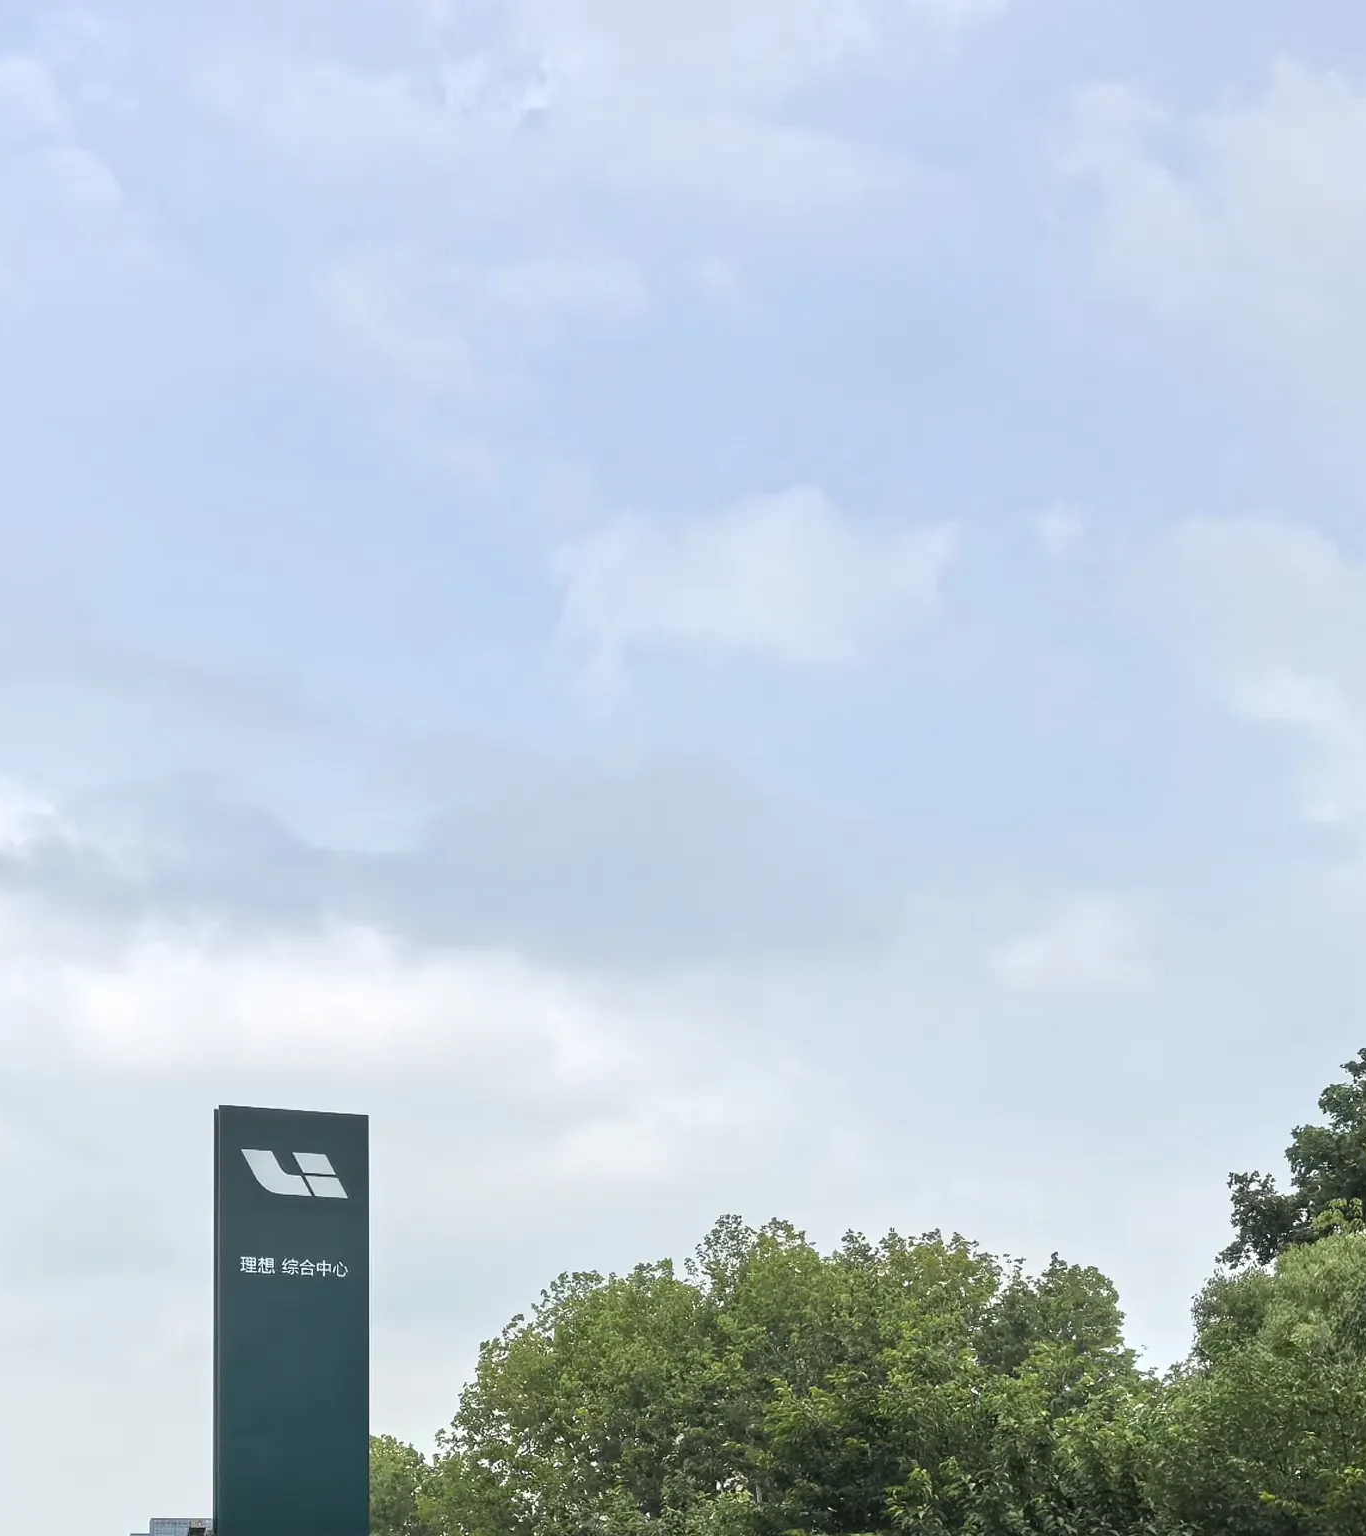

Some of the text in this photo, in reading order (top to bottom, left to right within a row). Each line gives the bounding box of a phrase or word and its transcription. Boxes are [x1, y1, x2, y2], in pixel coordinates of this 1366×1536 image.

[240, 1256, 348, 1277] 理想 综合中心
